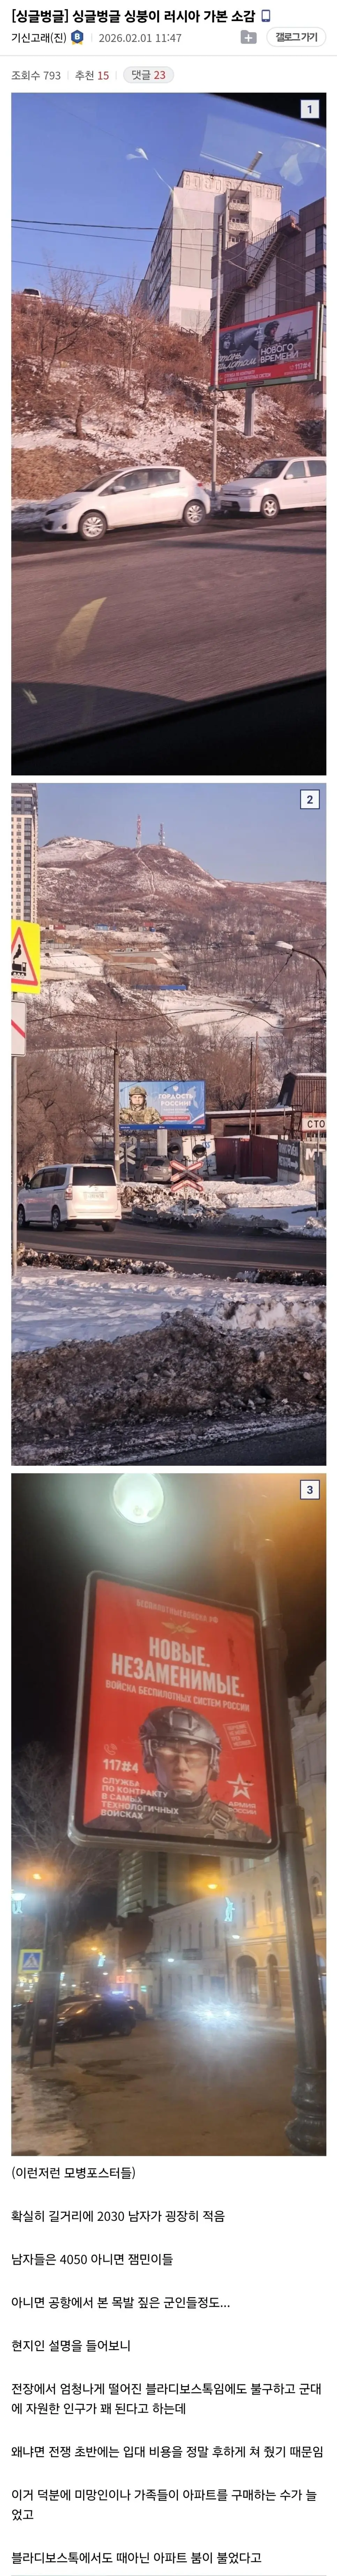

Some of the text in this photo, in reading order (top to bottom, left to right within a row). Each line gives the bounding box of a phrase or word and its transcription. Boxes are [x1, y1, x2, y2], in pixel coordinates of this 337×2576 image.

[13, 9, 255, 23] [싱글벙글] 싱글벙글 싱붕이 러시아 가본 소감
[12, 32, 66, 43] 기신고래(진)
[276, 32, 317, 42] 갤로그 가기
[12, 71, 60, 80] 조회수 793
[75, 71, 108, 80] 추천 15
[132, 70, 165, 80] 댓글 23
[261, 343, 294, 356] НОВОГО
[261, 350, 299, 364] ВРЕМЕНИ
[307, 1120, 325, 1128] СТО
[149, 1637, 210, 1667] НОВЫЕ.
[112, 1653, 245, 1697] НЕЗАМЕНИМЫЕ.
[106, 1679, 250, 1712] ВОЙСКА БЕСПИЛОТНЫХ СИСТЕМ РОССИИ
[103, 1759, 138, 1773] 117#4
[102, 1777, 140, 1787] СЛУЖБА
[110, 1793, 143, 1803] САМЫХ
[117, 1786, 168, 1798] КОНТРАКТУ
[100, 1809, 143, 1819] ВОЙСКАХ
[101, 1801, 179, 1815] ТЕХНОЛОГИЧНЫХ
[13, 2167, 135, 2179] (이런저런 모병포스터들)
[12, 2211, 225, 2222] 확실히 길거리에 2030 남자가 굉장히 적음
[12, 2254, 173, 2265] 남자들은 4050 아니면 잼민이들
[12, 2297, 230, 2308] 아니면 공항에서 본 목발 짚은 군인들정도...
[12, 2340, 129, 2352] 현지인 설명을 들어보니
[12, 2383, 321, 2395] 전장에서 엄청나게 떨어진 블라디보스톡임에도 불구하고 군대
[12, 2403, 185, 2414] 에 자원한 인구가 꽤 된다고 하는데
[12, 2446, 322, 2458] 왜냐면 전쟁 초반에는 입대 비용을 정말 후하게 쳐 줬기 때문임
[12, 2489, 316, 2501] 이거 덕분에 미망인이나 가족들이 아파트를 구매하는 수가 늘
[12, 2509, 33, 2520] 었고
[12, 2552, 261, 2564] 블라디보스톡에서도 때아닌 아파트 붐이 불었다고
